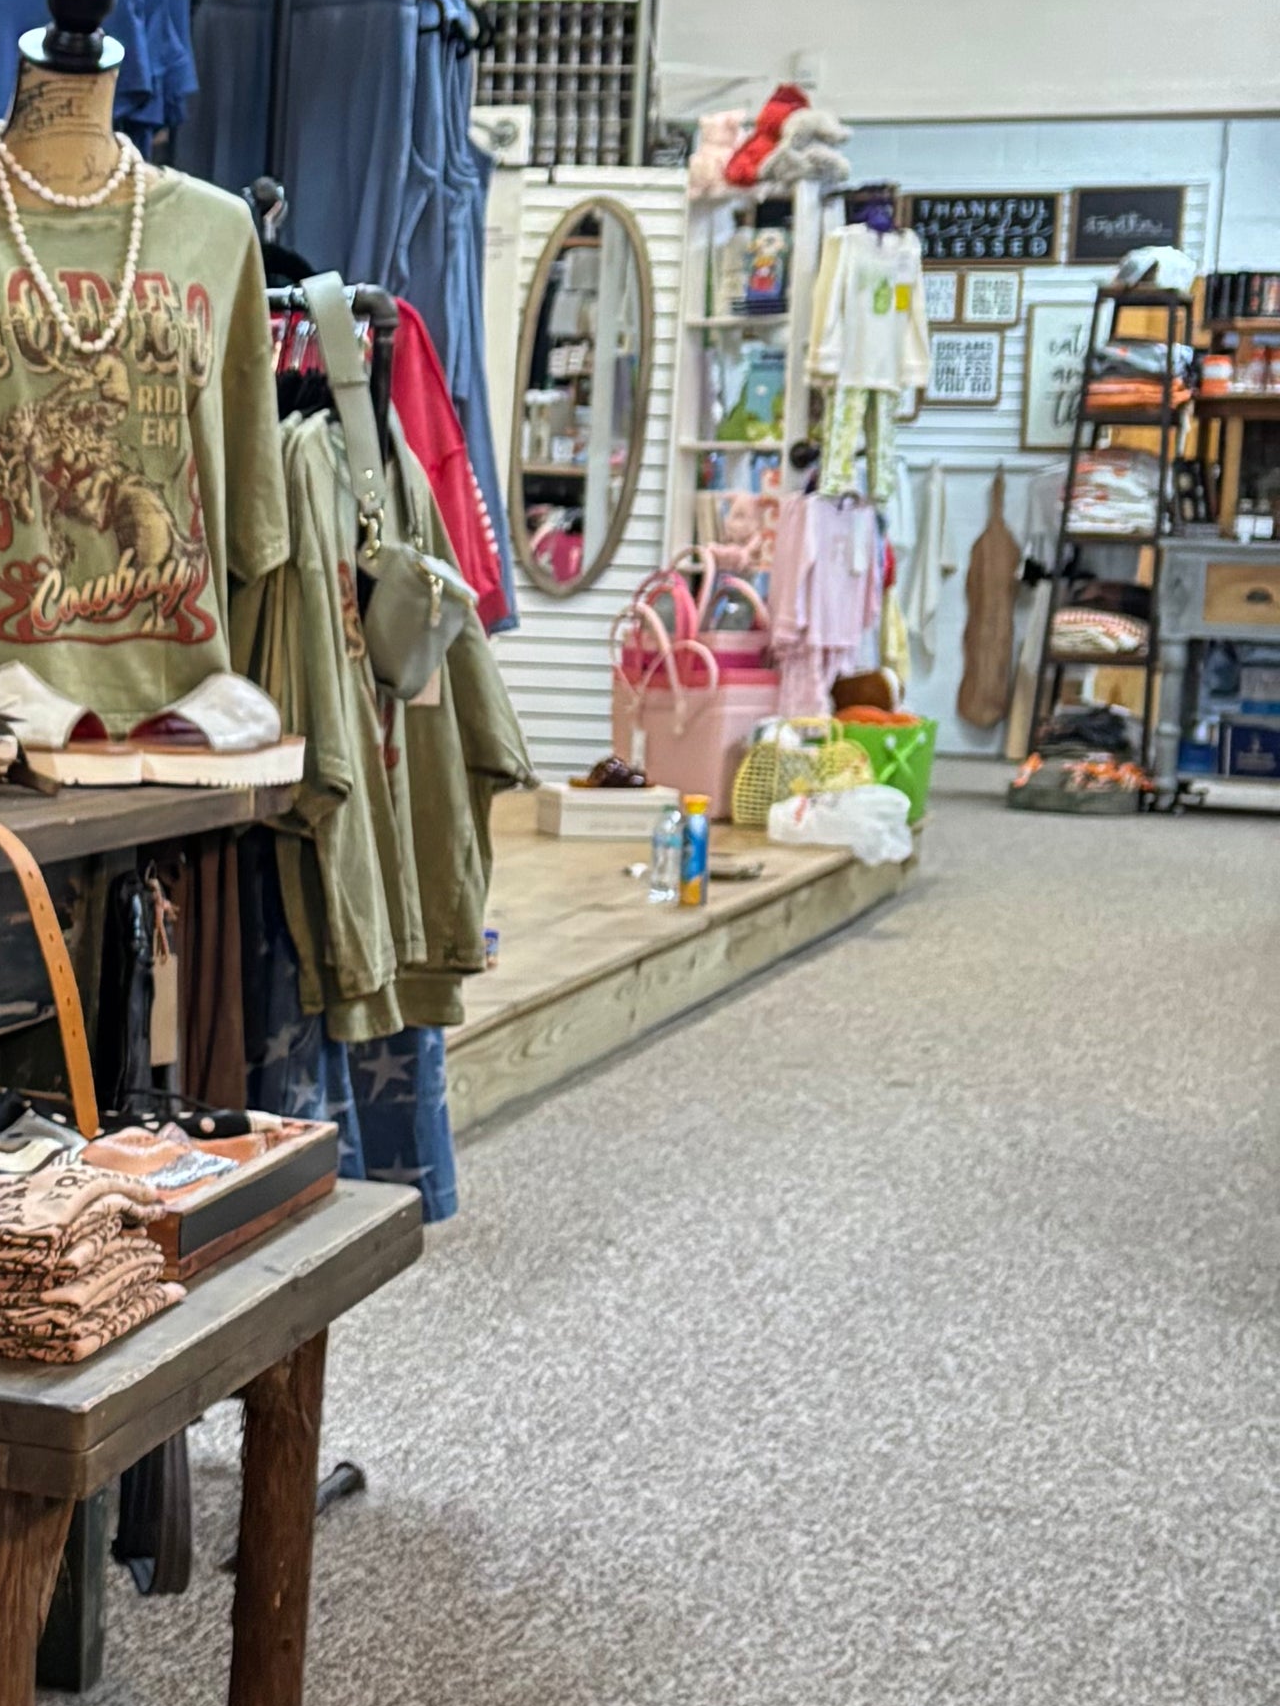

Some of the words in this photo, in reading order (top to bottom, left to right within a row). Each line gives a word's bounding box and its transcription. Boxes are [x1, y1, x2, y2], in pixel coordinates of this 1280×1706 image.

[919, 198, 1048, 222] THANKFUL
[137, 385, 180, 414] RID
[31, 547, 193, 631] Cowboy
